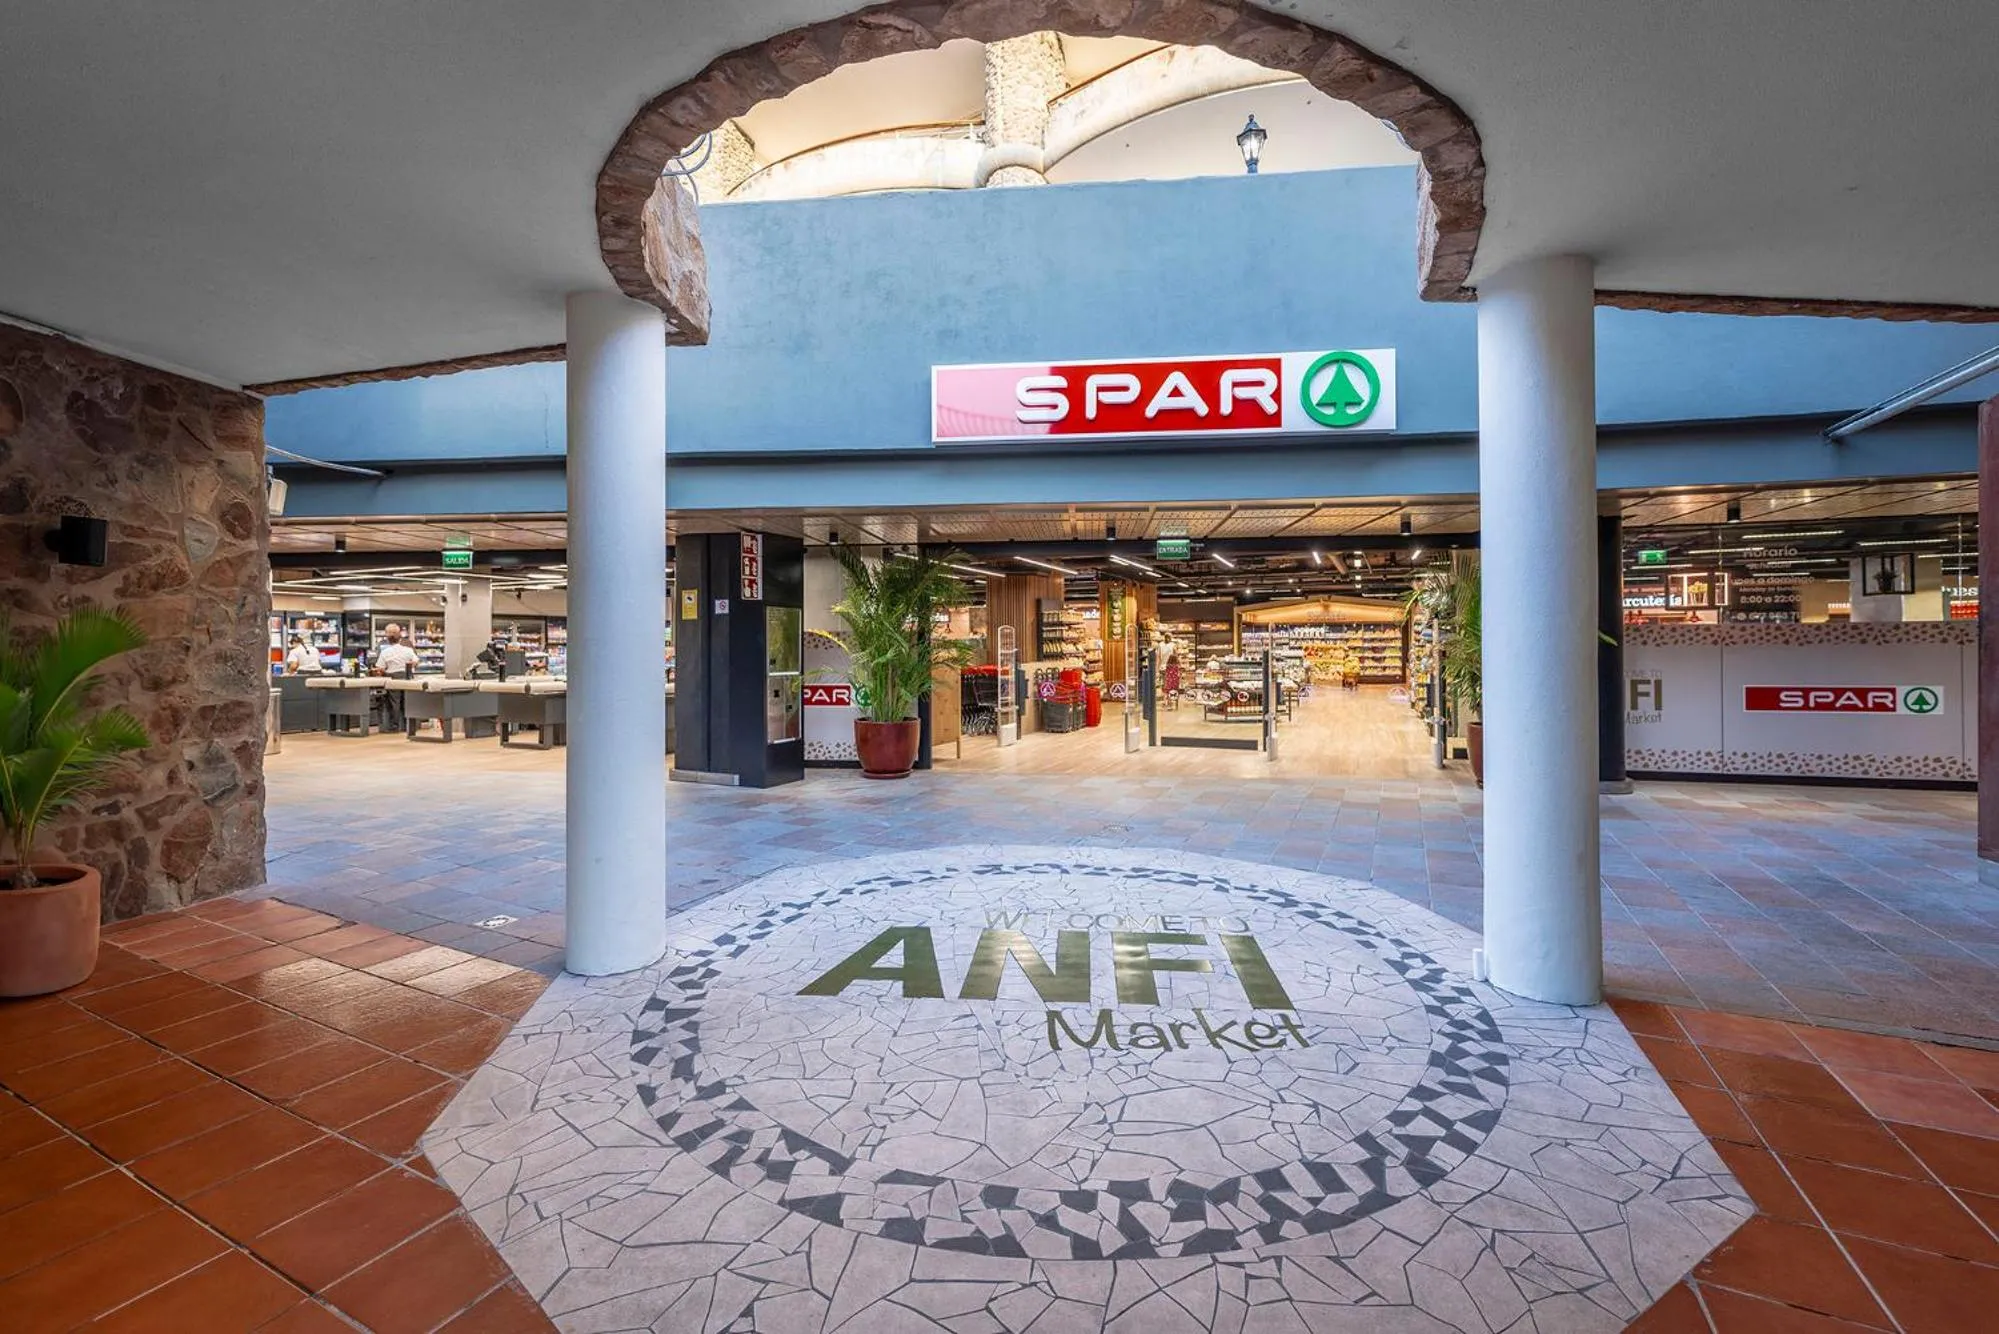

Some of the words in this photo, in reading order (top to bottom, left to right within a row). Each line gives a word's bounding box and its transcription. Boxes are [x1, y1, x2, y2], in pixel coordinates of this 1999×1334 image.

[1016, 368, 1278, 424] SPAR
[446, 557, 470, 565] SALIDA
[803, 688, 850, 703] PAR
[1630, 679, 1662, 710] FI
[1779, 690, 1895, 709] SPAR
[795, 926, 1295, 1010] ANFI
[1047, 1008, 1309, 1052] Market
